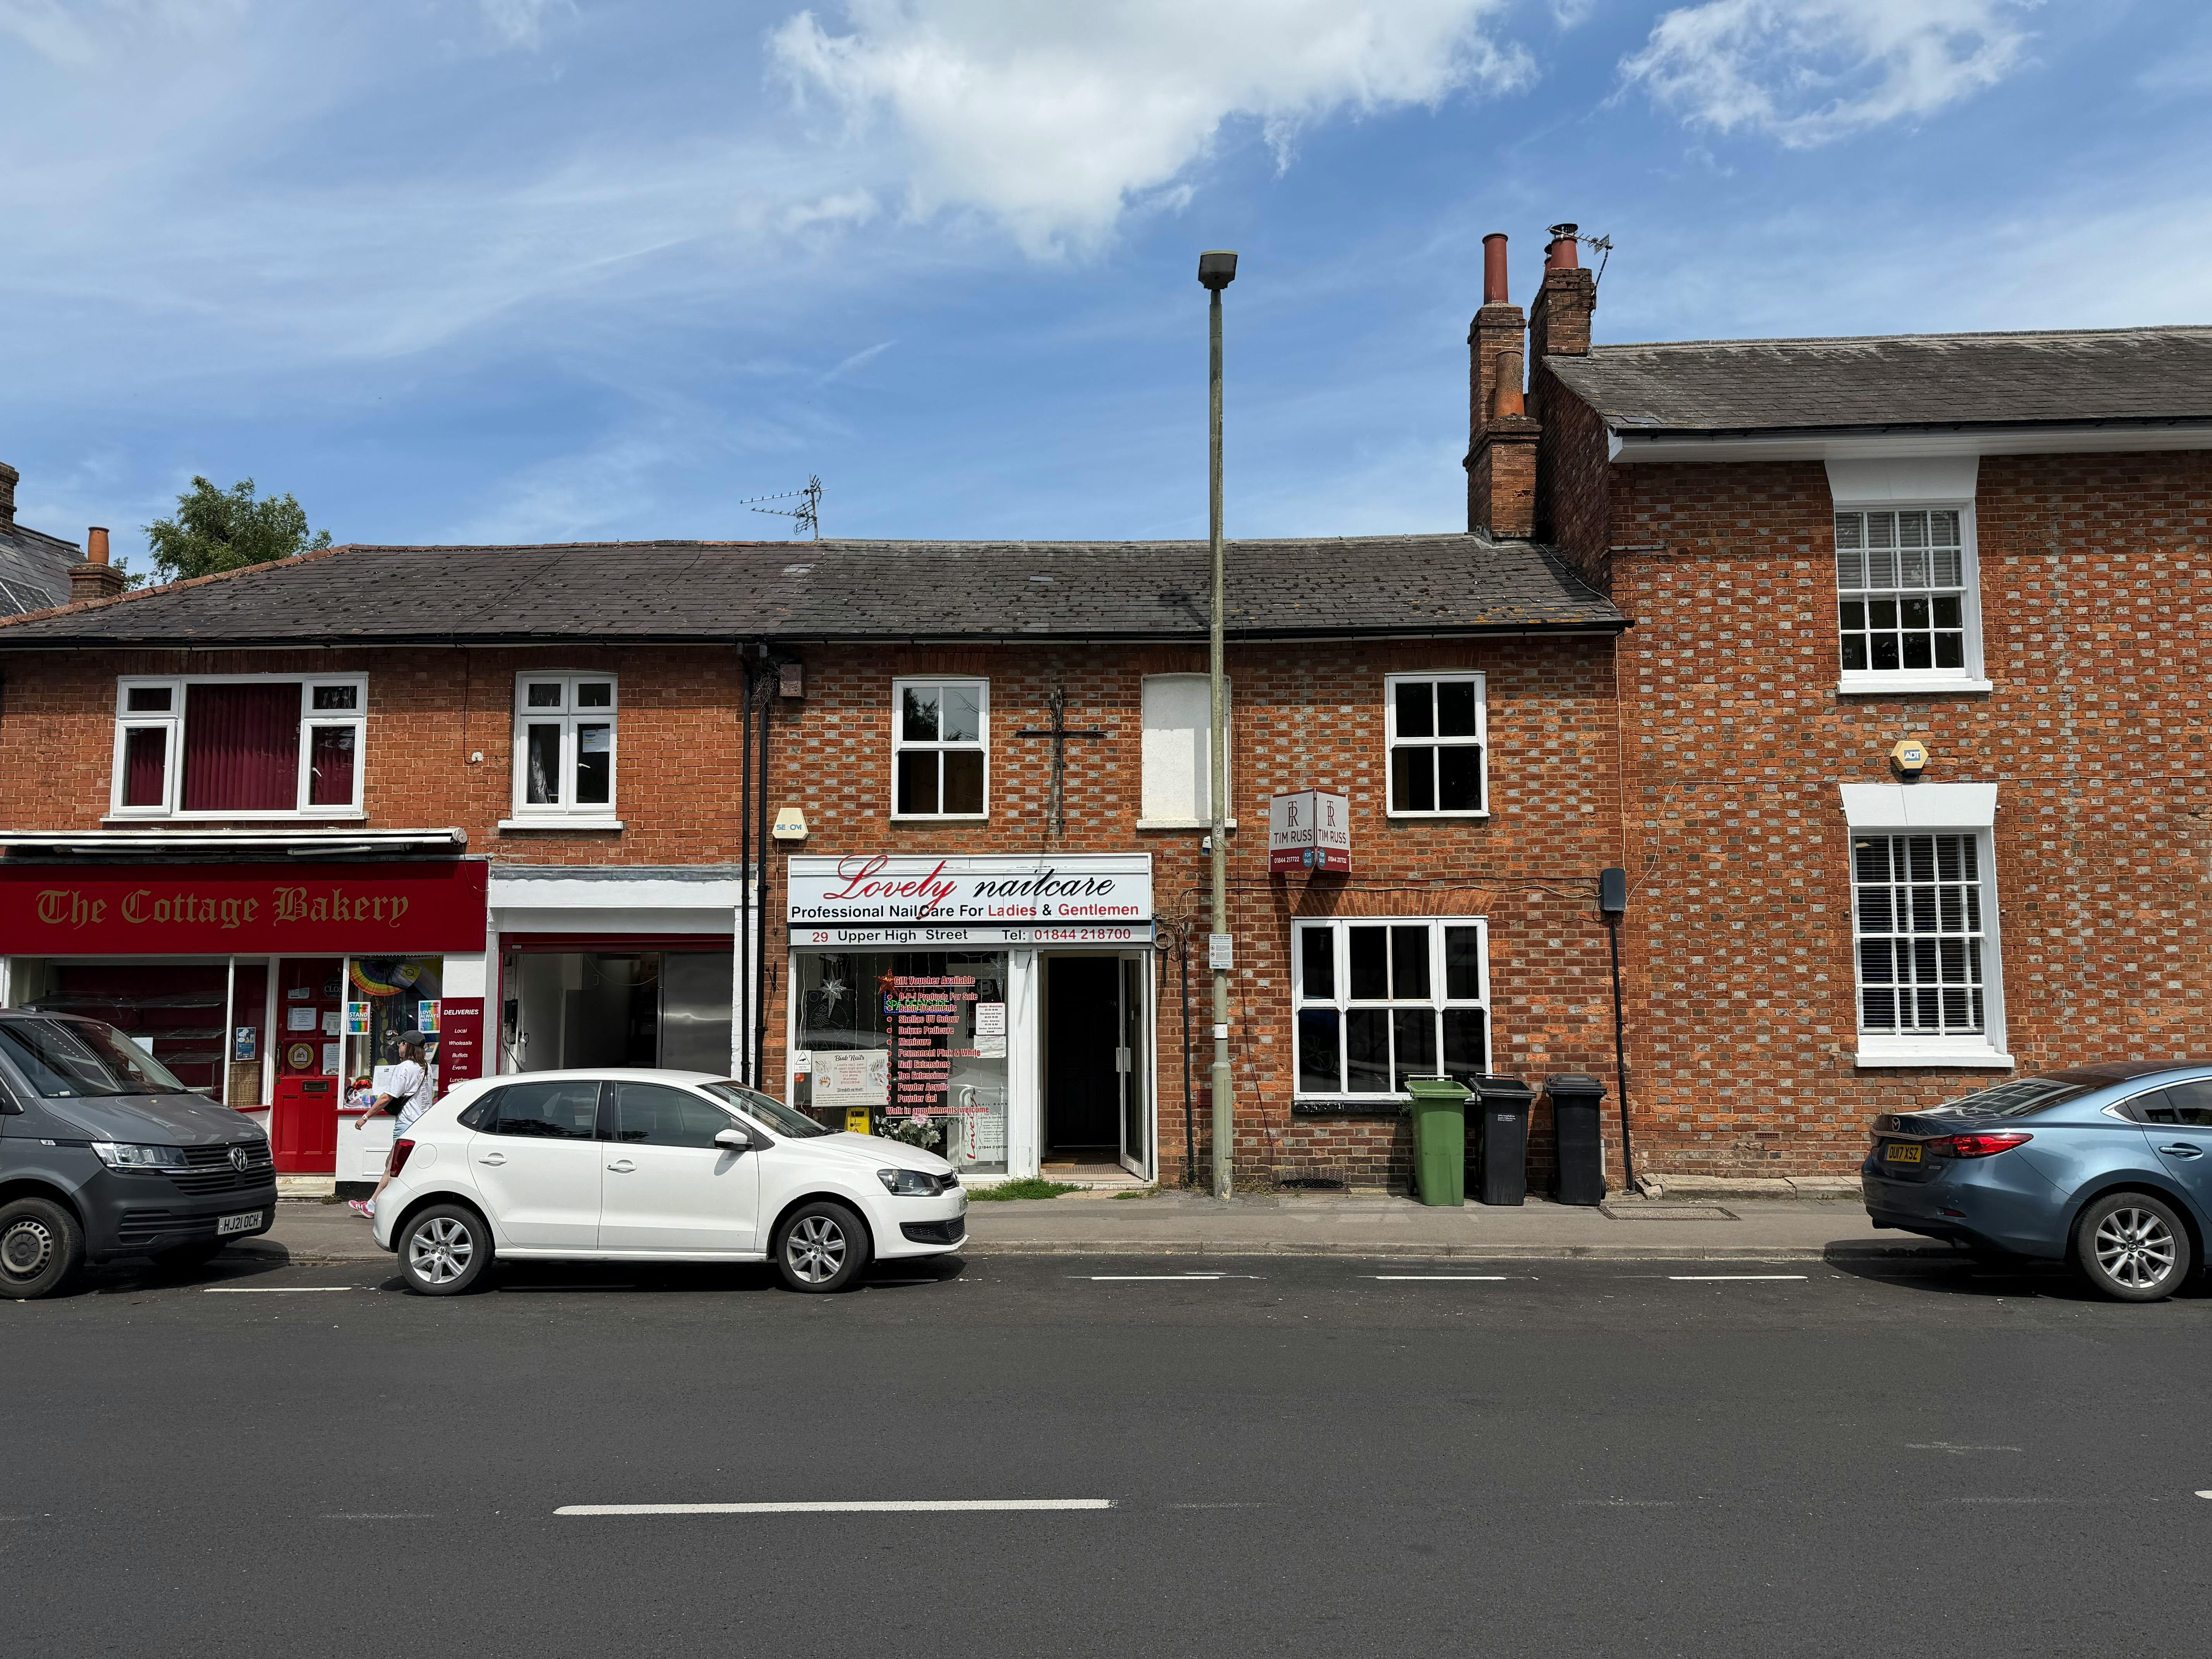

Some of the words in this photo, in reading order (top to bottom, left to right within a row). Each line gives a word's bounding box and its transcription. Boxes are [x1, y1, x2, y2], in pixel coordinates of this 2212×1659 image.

[1274, 832, 1288, 844] TIM
[1291, 829, 1312, 843] RUSS
[1318, 829, 1328, 842] TIM
[1330, 830, 1346, 844] RUSS
[823, 854, 957, 920] Lovely
[972, 868, 1115, 898] nailcare
[36, 889, 107, 929] The
[121, 889, 259, 929] Cottage
[273, 886, 409, 927] Bakery
[792, 905, 883, 918] Professional
[960, 905, 984, 917] For
[988, 904, 1037, 916] Ladies
[1042, 904, 1052, 916] &
[1058, 903, 1139, 915] Gentlemen
[812, 932, 828, 943] 29
[838, 931, 881, 943] Upper
[885, 930, 916, 943] High
[926, 929, 968, 940] Street
[1001, 929, 1026, 940] Tel:
[1034, 929, 1076, 940] 01844
[1080, 928, 1131, 939] 218700
[894, 976, 907, 985] Gift
[909, 976, 939, 985] Voucher
[941, 975, 975, 985] Available
[918, 993, 948, 1001] Products
[962, 992, 978, 1000] Sale
[898, 1015, 924, 1023] Shellac
[926, 1015, 935, 1023] UV
[936, 1015, 960, 1023] Colour
[898, 1049, 936, 1057] Permanent
[937, 1049, 953, 1057] Pink
[961, 1048, 981, 1057] White
[898, 1060, 912, 1068] Nail
[914, 1060, 951, 1068] Extensions
[897, 1072, 912, 1080] Toe
[912, 1072, 949, 1080] Extensions
[897, 1083, 924, 1091] Powder
[925, 1083, 950, 1091] Acrylic
[897, 1094, 924, 1103] Powder
[925, 1094, 938, 1103] Gel
[912, 1107, 957, 1115] appointments
[1889, 1146, 1904, 1159] OU17
[1904, 1147, 1918, 1160] XSZ
[223, 1216, 243, 1231] HJ21
[244, 1214, 259, 1228] OCH
